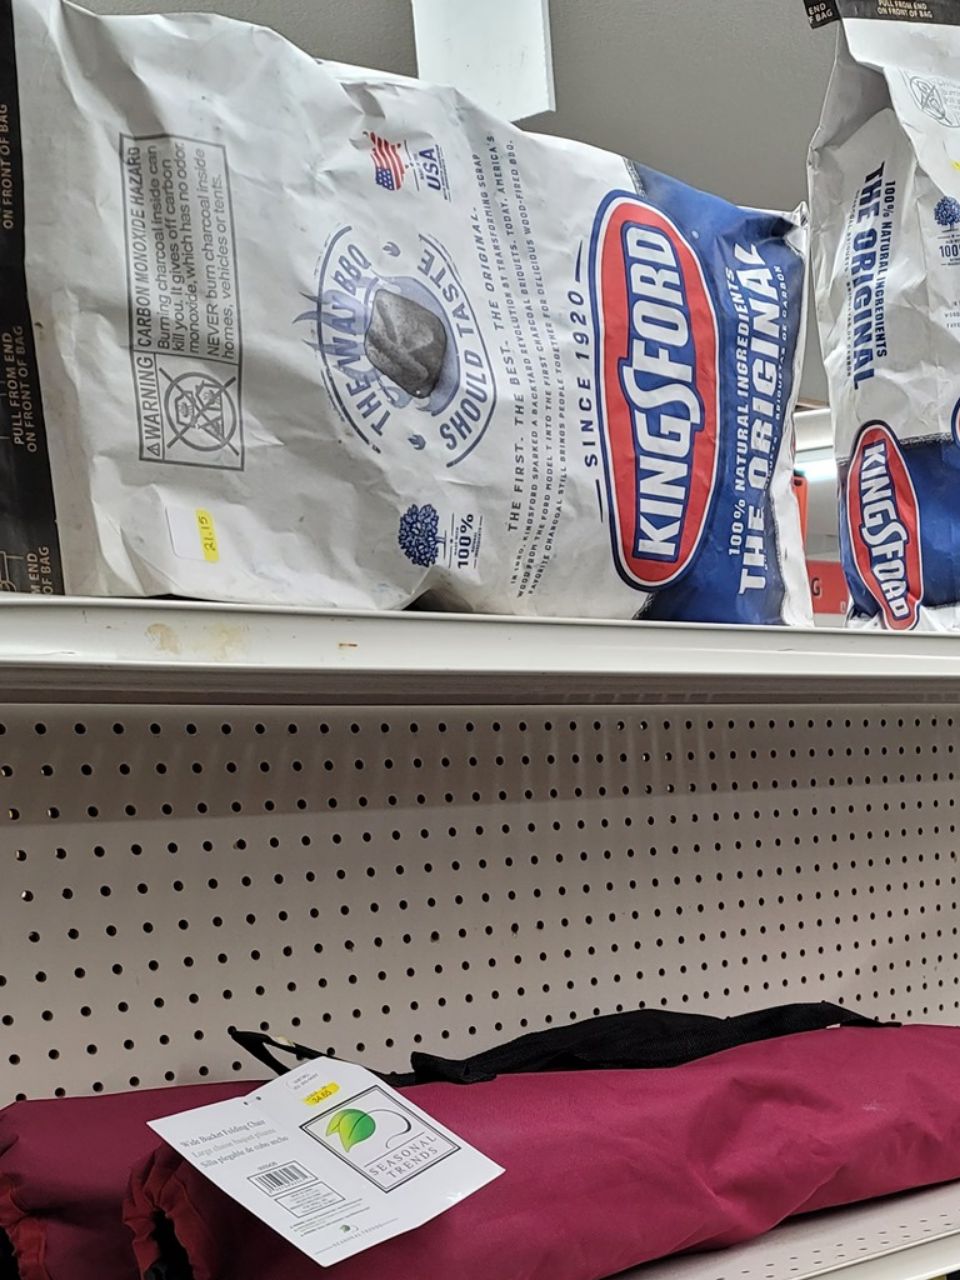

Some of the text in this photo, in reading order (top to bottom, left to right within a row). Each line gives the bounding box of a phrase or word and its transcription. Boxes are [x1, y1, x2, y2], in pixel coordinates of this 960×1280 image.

[124, 147, 152, 348] CARBON MONOXIDE HAZARD
[148, 145, 171, 350] Burning charcoal inside can
[196, 148, 220, 357] NEVER burn charcoal inside
[419, 147, 441, 191] USA
[332, 244, 391, 437] THE WAY BBQ
[418, 249, 487, 450] SHOULD TASTE
[850, 161, 885, 390] THE ORIGINAL
[874, 180, 896, 357] 100% NATURAL INGREDIENTS
[4, 332, 25, 445] PULL FROM END
[14, 326, 37, 453] ON FRONT OF BAG
[143, 357, 160, 439] WARNING
[472, 206, 526, 532] THE FIRST. THE BEST. THE ORIGINAL.
[568, 290, 598, 468] SINCE 1920
[623, 222, 705, 558] KINGSFORD
[725, 268, 750, 556] 100% NATURAL INGREDIENTS
[734, 243, 784, 594] THE ORIGINAL
[28, 553, 38, 581] END
[457, 514, 475, 569] 100%
[859, 442, 909, 618] KINGSFORD
[369, 1135, 438, 1176] SEASONAL
[386, 1146, 438, 1178] TRENDS
